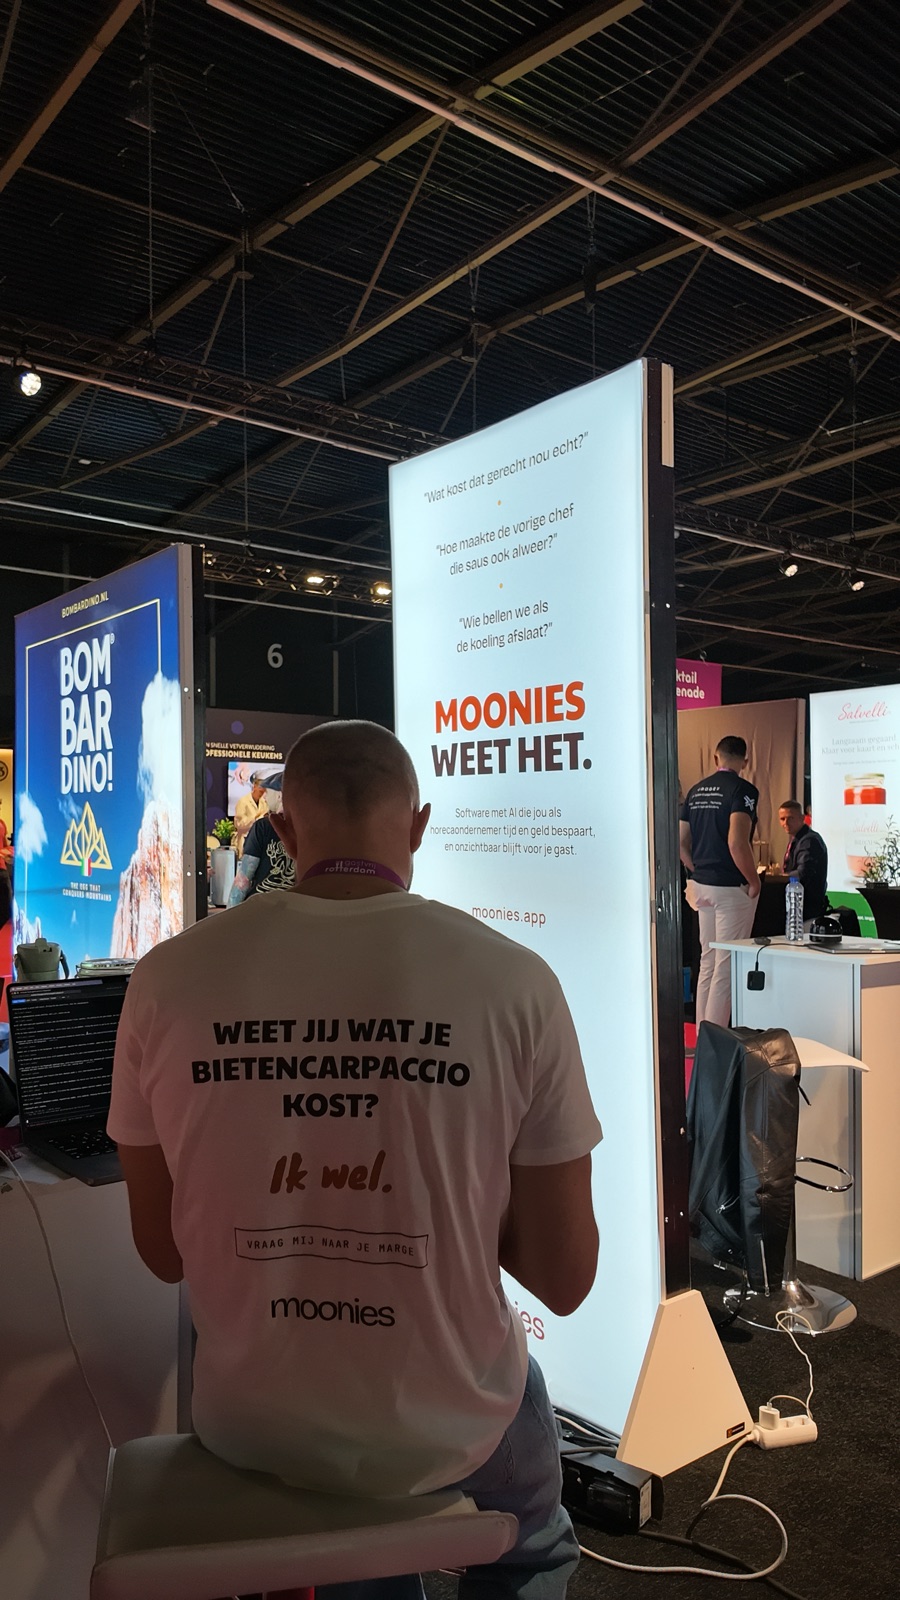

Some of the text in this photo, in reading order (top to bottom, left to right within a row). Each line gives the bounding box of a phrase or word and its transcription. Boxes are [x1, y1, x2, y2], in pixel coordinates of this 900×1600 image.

[447, 479, 467, 497] kost
[469, 474, 485, 490] dat
[487, 459, 526, 486] gerecht
[529, 450, 550, 467] nou
[459, 528, 496, 550] maakte
[498, 525, 511, 539] de
[512, 514, 546, 534] vorige
[548, 503, 575, 523] chef
[450, 561, 464, 575] die
[466, 555, 489, 571] saus
[491, 548, 510, 565] ook
[61, 591, 109, 618] BOMBARDINO.NL
[483, 609, 513, 625] bellen
[515, 606, 531, 618] we
[533, 600, 549, 615] als
[267, 643, 284, 668] 6
[456, 639, 469, 653] de
[470, 633, 505, 651] koeling
[435, 681, 586, 734] MOONIES
[837, 701, 888, 721] Salvelli
[60, 689, 113, 756] BAR
[251, 751, 283, 760] KEUKENS
[431, 731, 592, 777] WEET HET.
[60, 751, 113, 795] DINO!
[455, 806, 562, 821] Software met AI die jou als
[430, 825, 596, 839] horecaondernemer tijd en geld bespaart,
[444, 842, 577, 858] en onzichtbaar blijft voor je gast.
[325, 861, 376, 875] rotterdam
[472, 906, 547, 928] moonies.app
[213, 1018, 452, 1047] WEET JIJ WAT JE
[191, 1055, 470, 1087] BIETENCARPACCIO
[283, 1093, 379, 1118] KOST?
[269, 1149, 393, 1194] Ik wel.
[247, 1236, 415, 1257] VRAAG MIJ NAAR JE MARGE
[271, 1296, 396, 1327] moonies
[515, 1300, 545, 1341] es
